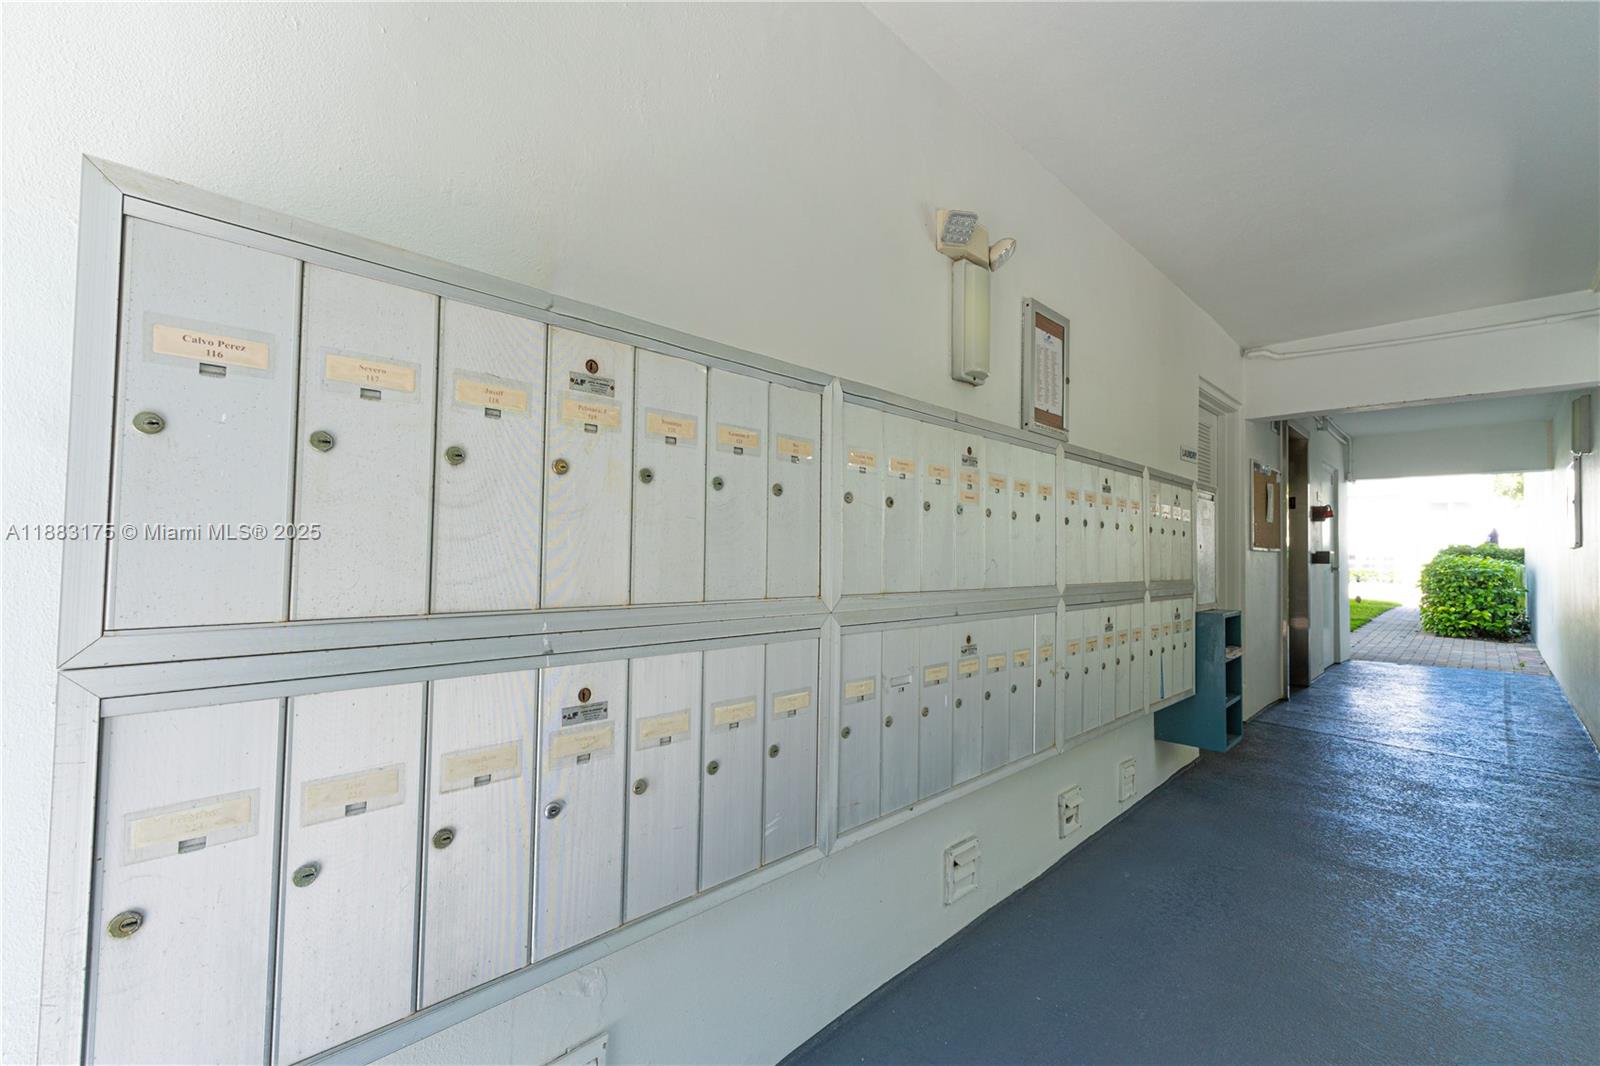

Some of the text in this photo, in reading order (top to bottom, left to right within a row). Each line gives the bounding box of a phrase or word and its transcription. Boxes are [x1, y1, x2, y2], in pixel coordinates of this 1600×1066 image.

[182, 334, 246, 352] Calvo Perez
[207, 349, 224, 359] 116
[366, 375, 379, 383] 117
